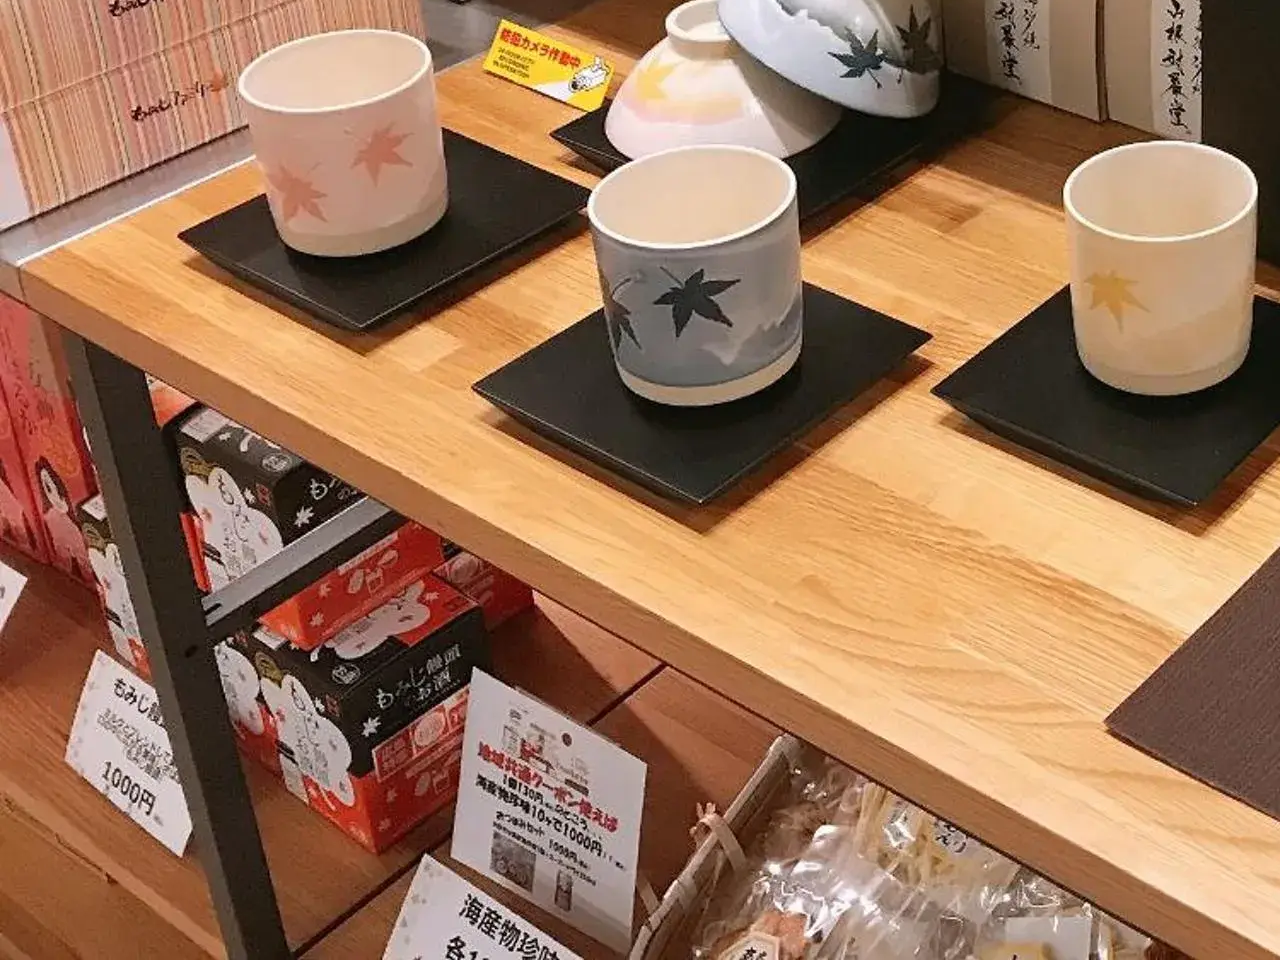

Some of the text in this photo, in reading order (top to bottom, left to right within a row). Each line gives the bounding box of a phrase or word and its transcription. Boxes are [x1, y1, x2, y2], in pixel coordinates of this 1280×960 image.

[500, 28, 581, 69] 防犯カメラ作動中
[102, 761, 156, 816] 1000円
